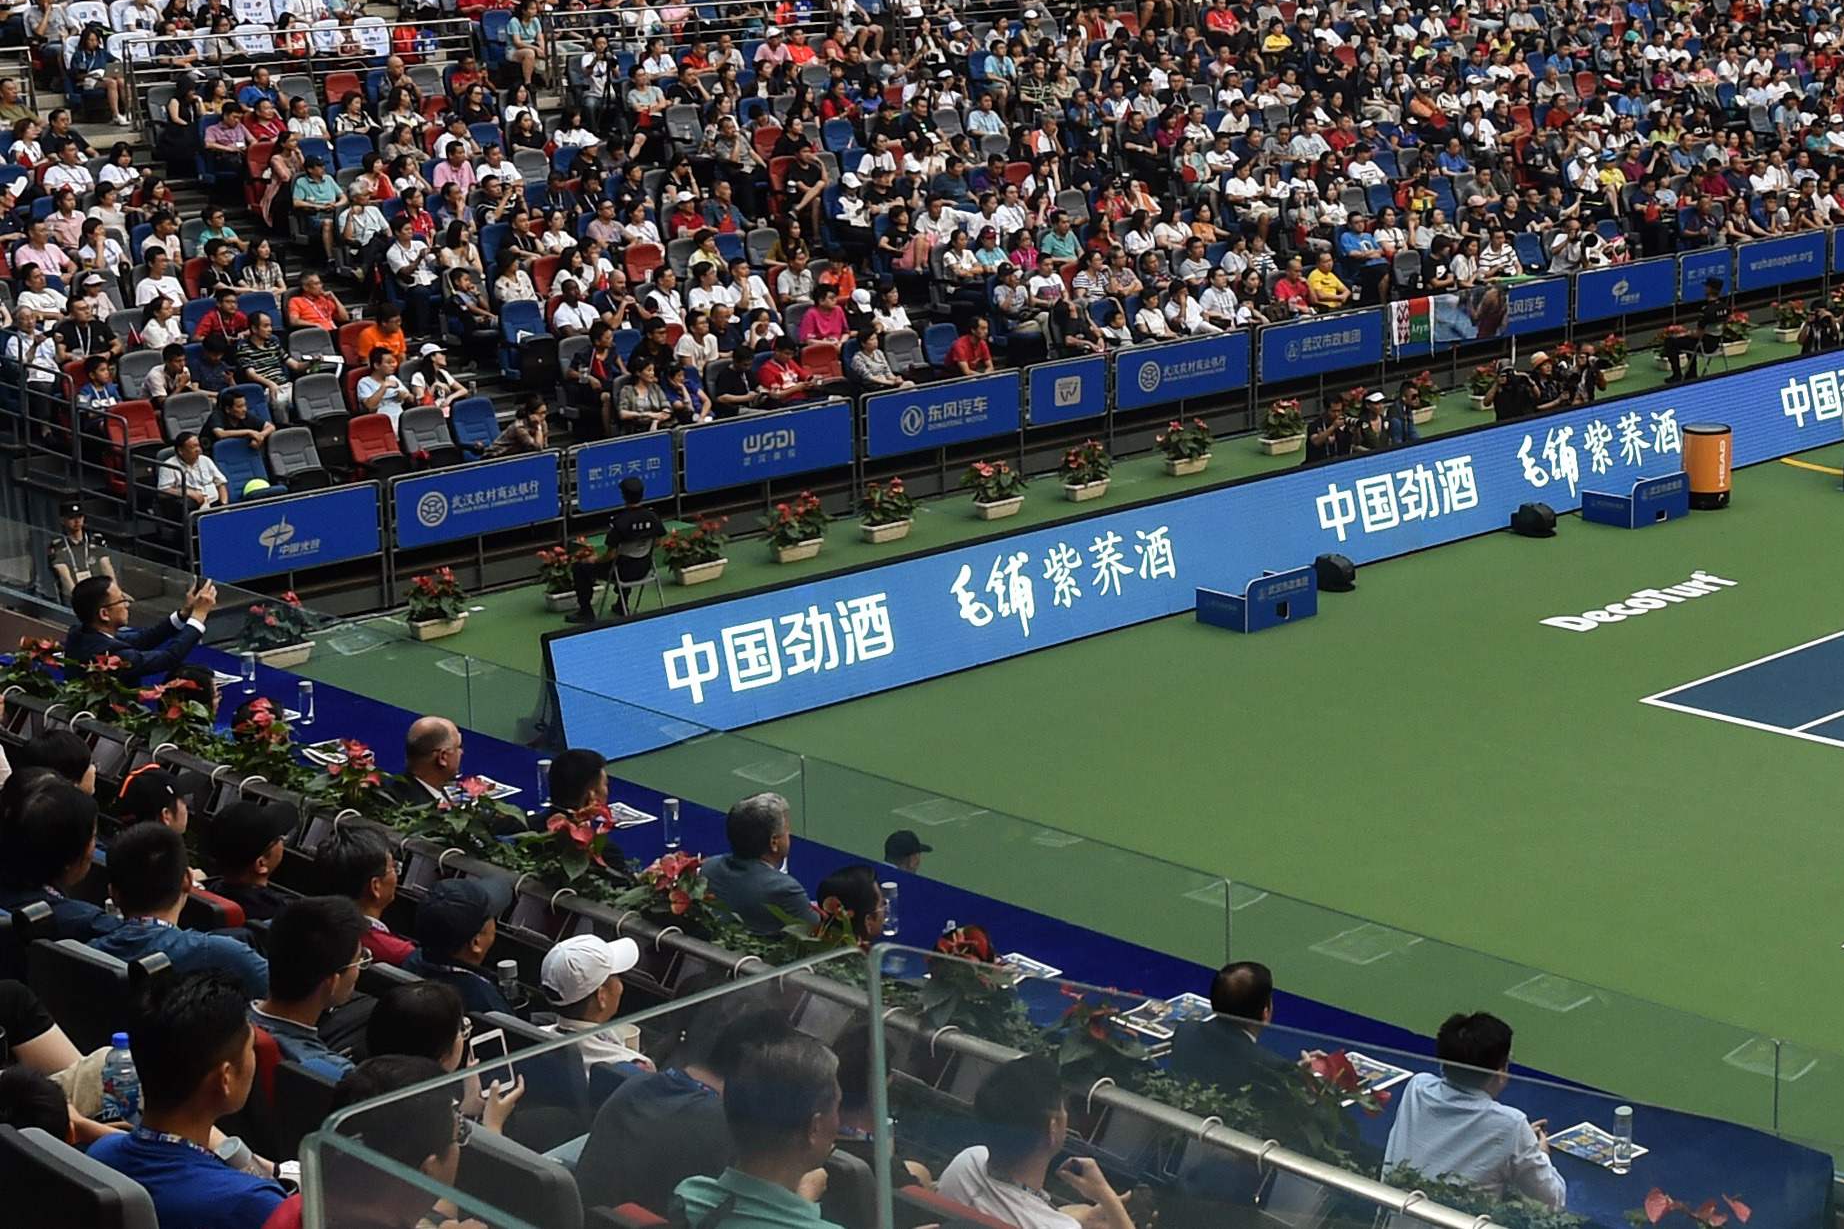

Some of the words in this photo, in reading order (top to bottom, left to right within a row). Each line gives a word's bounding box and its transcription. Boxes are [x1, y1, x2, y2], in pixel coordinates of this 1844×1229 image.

[928, 396, 989, 423] 东风汽车
[1718, 439, 1727, 488] HEAD
[1316, 455, 1478, 542] 中国劲酒
[1539, 570, 1738, 632] DecoTurf
[663, 592, 894, 704] 中国劲酒
